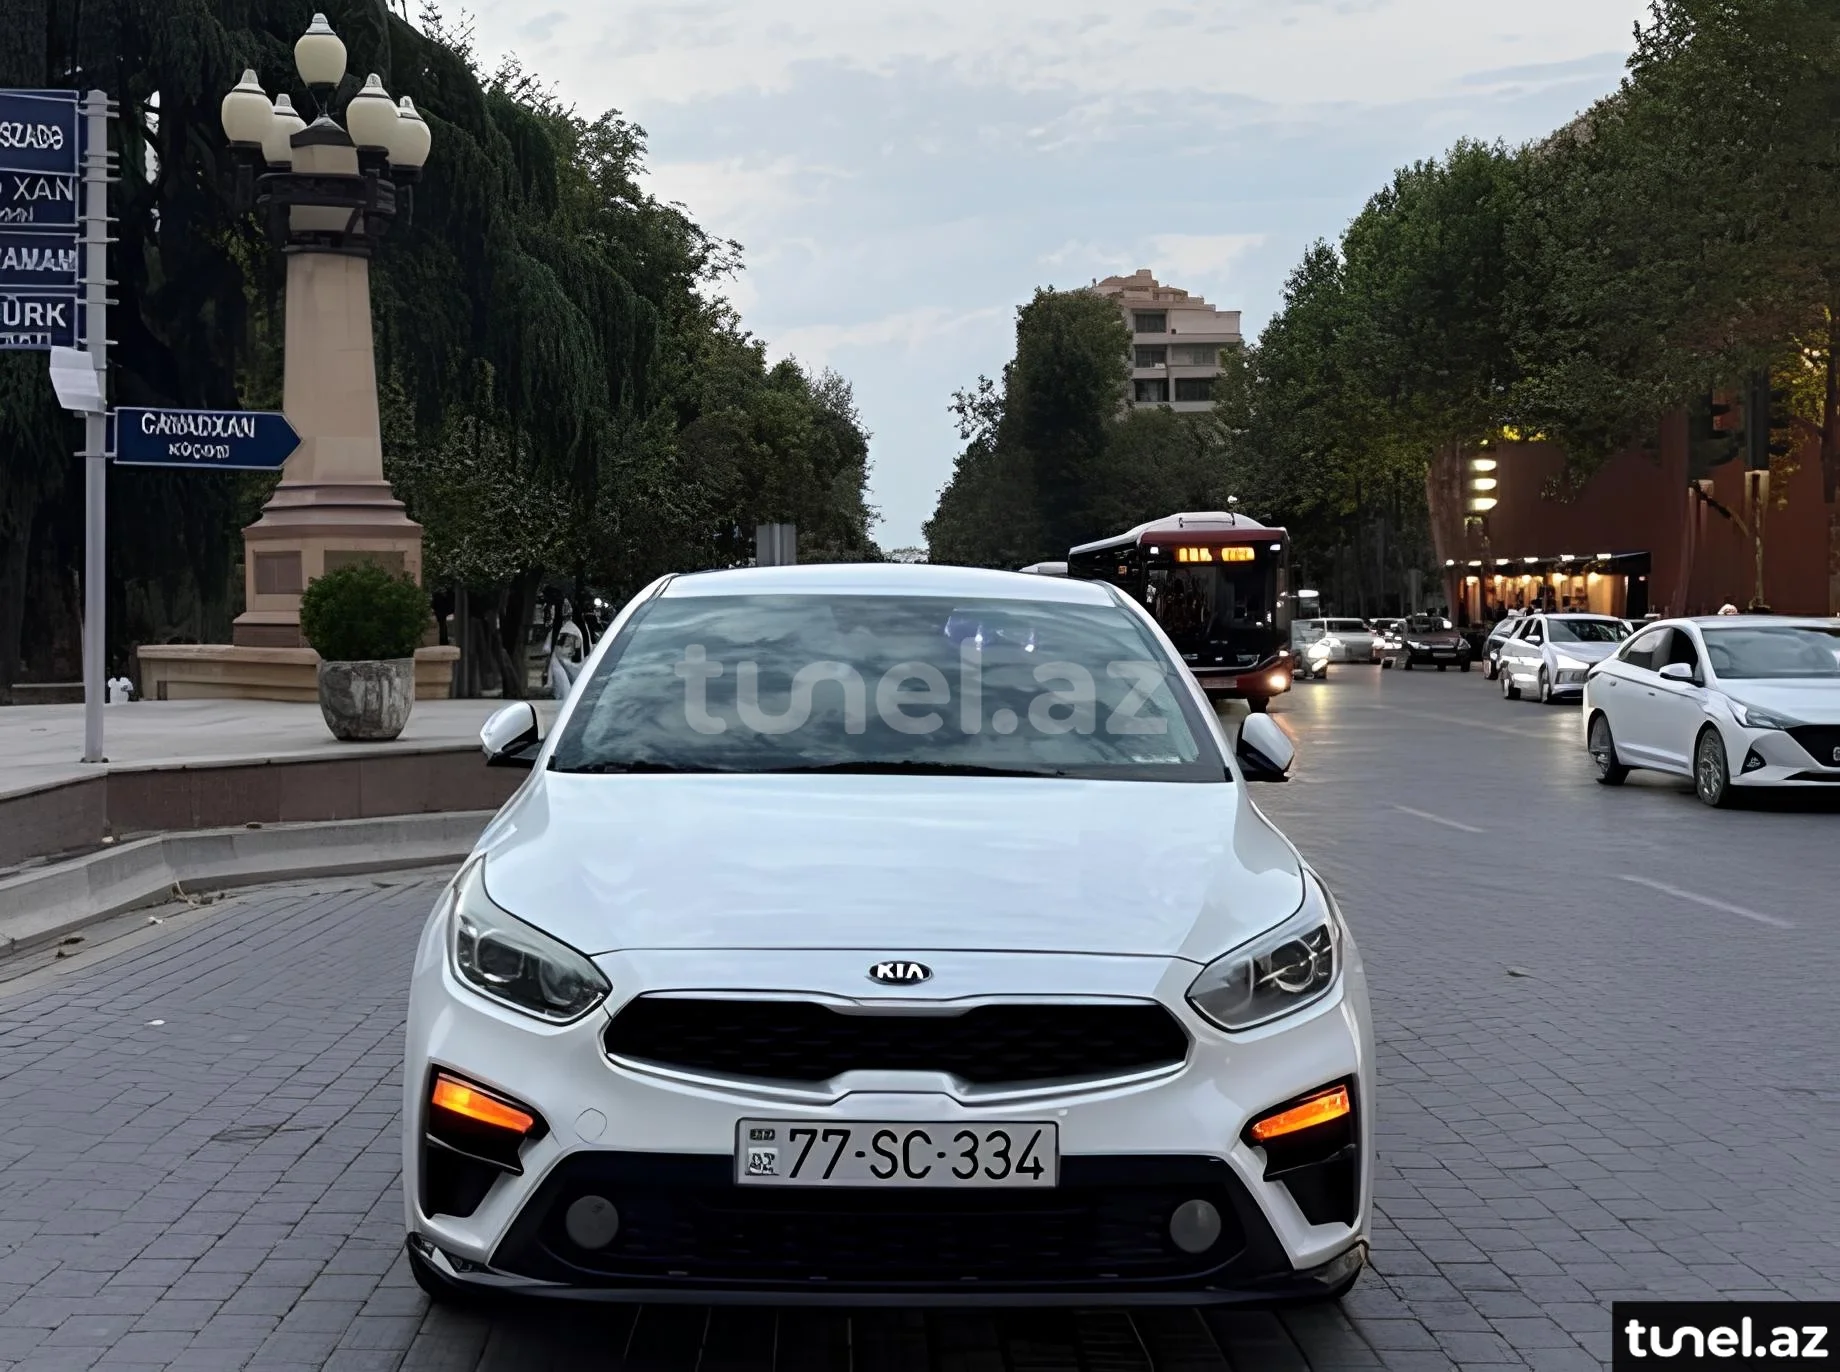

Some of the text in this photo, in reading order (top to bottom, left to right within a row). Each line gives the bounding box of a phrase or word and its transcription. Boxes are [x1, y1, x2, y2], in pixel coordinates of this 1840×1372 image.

[13, 176, 73, 201] XAN
[877, 963, 924, 979] KIA
[789, 1128, 1045, 1180] 77-SC-334
